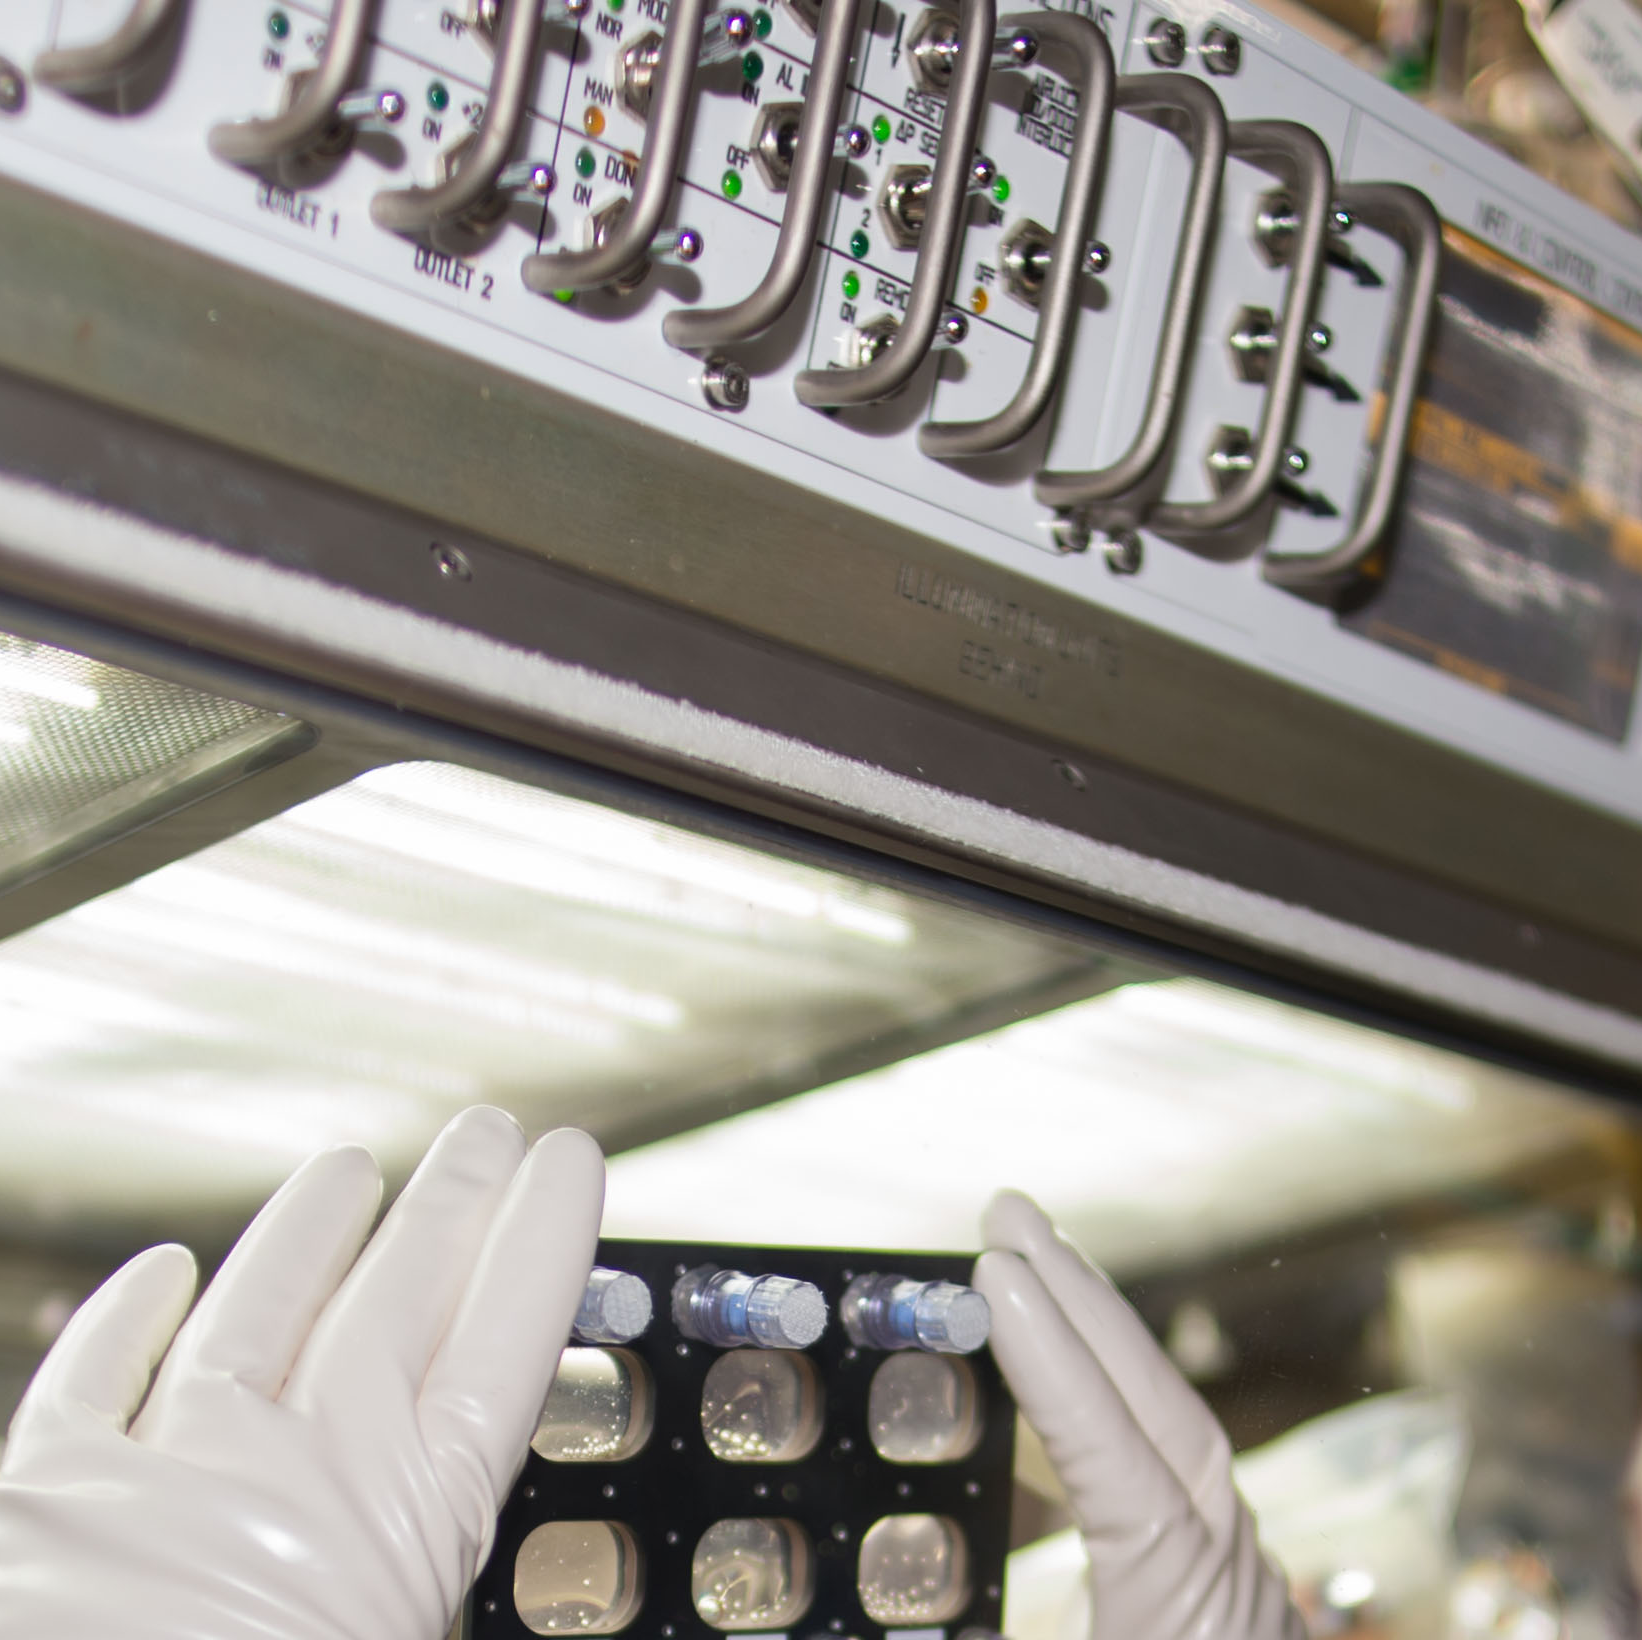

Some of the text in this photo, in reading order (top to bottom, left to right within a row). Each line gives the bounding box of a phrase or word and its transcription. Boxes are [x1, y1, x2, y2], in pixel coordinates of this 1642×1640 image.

[596, 13, 623, 40] NOR
[584, 75, 614, 107] MAN
[741, 82, 760, 106] ON
[422, 118, 443, 142] ON
[726, 144, 750, 170] OFF
[876, 147, 883, 166] 1
[920, 130, 941, 159] SE
[573, 183, 593, 207] ON
[255, 180, 339, 238] OUTLET 1
[860, 207, 871, 228] 2
[413, 245, 494, 301] OUTLET 2
[840, 301, 857, 324] ON
